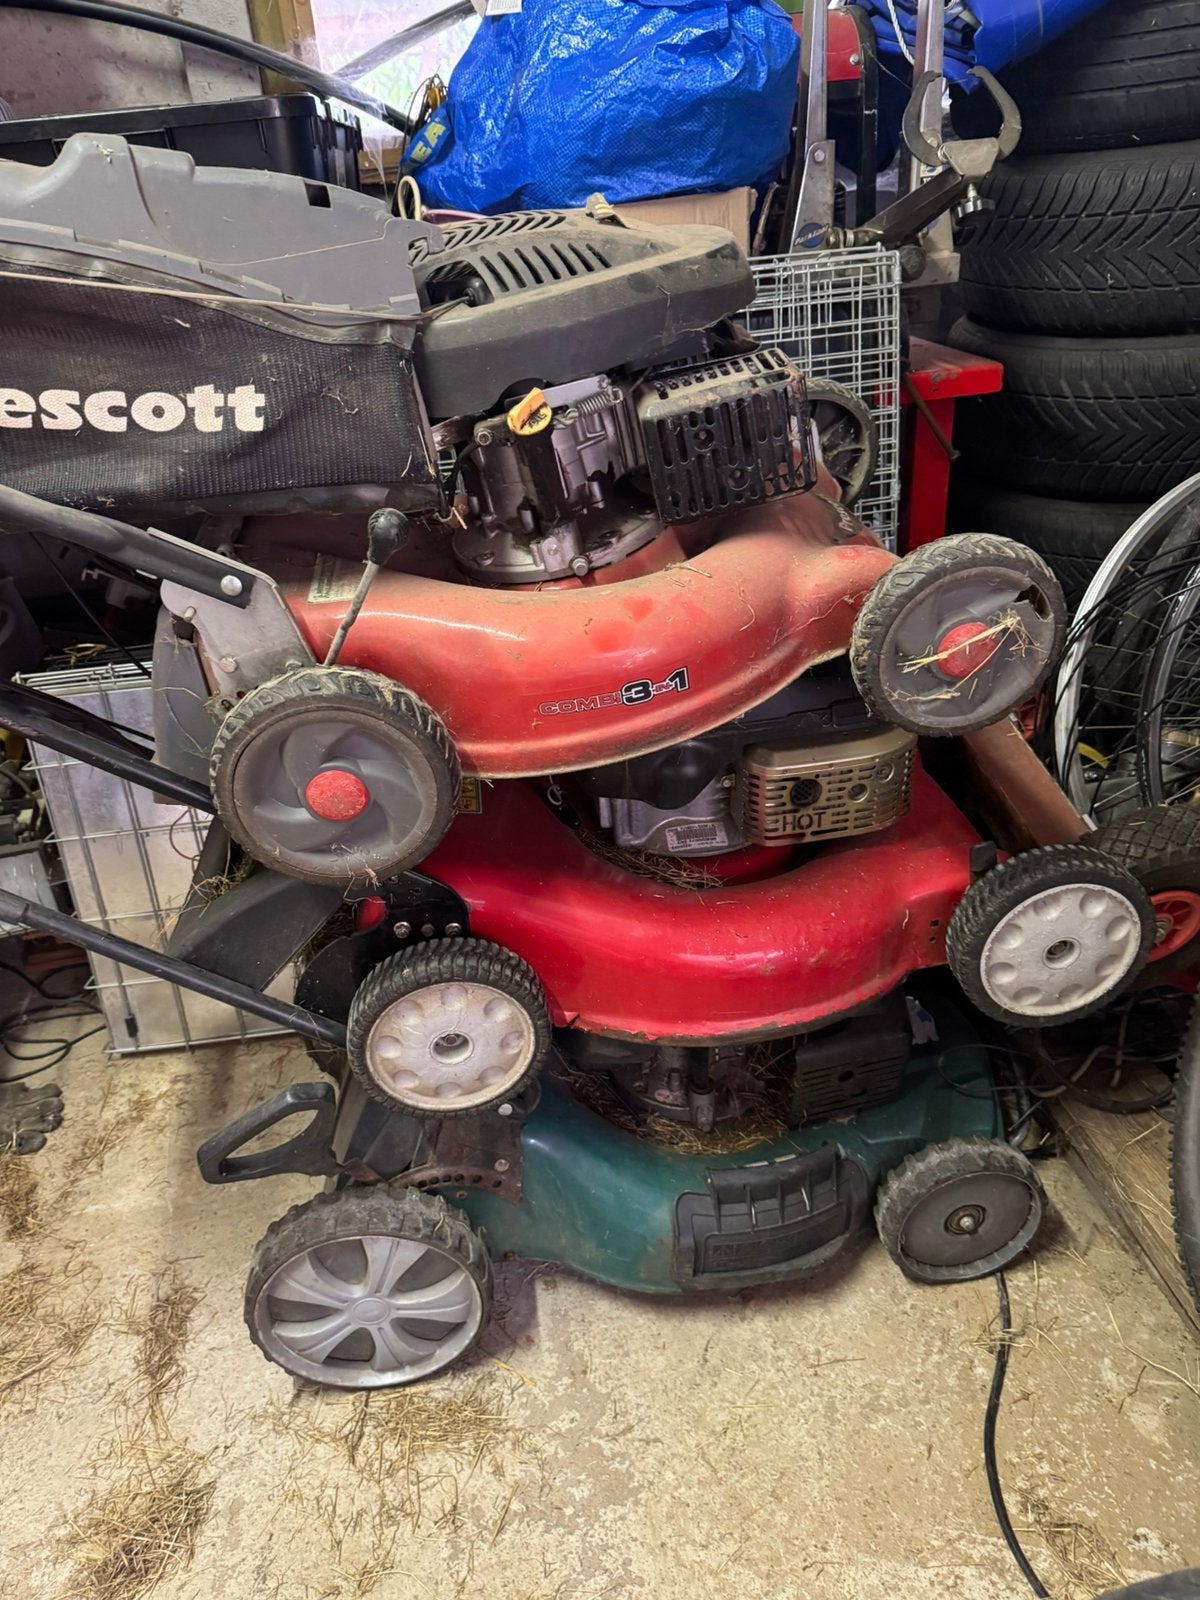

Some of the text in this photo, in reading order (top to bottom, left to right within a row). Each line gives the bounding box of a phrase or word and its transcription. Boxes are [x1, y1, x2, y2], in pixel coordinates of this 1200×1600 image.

[0, 384, 265, 432] escott
[538, 691, 622, 715] COMBI
[782, 811, 827, 832] HOT
